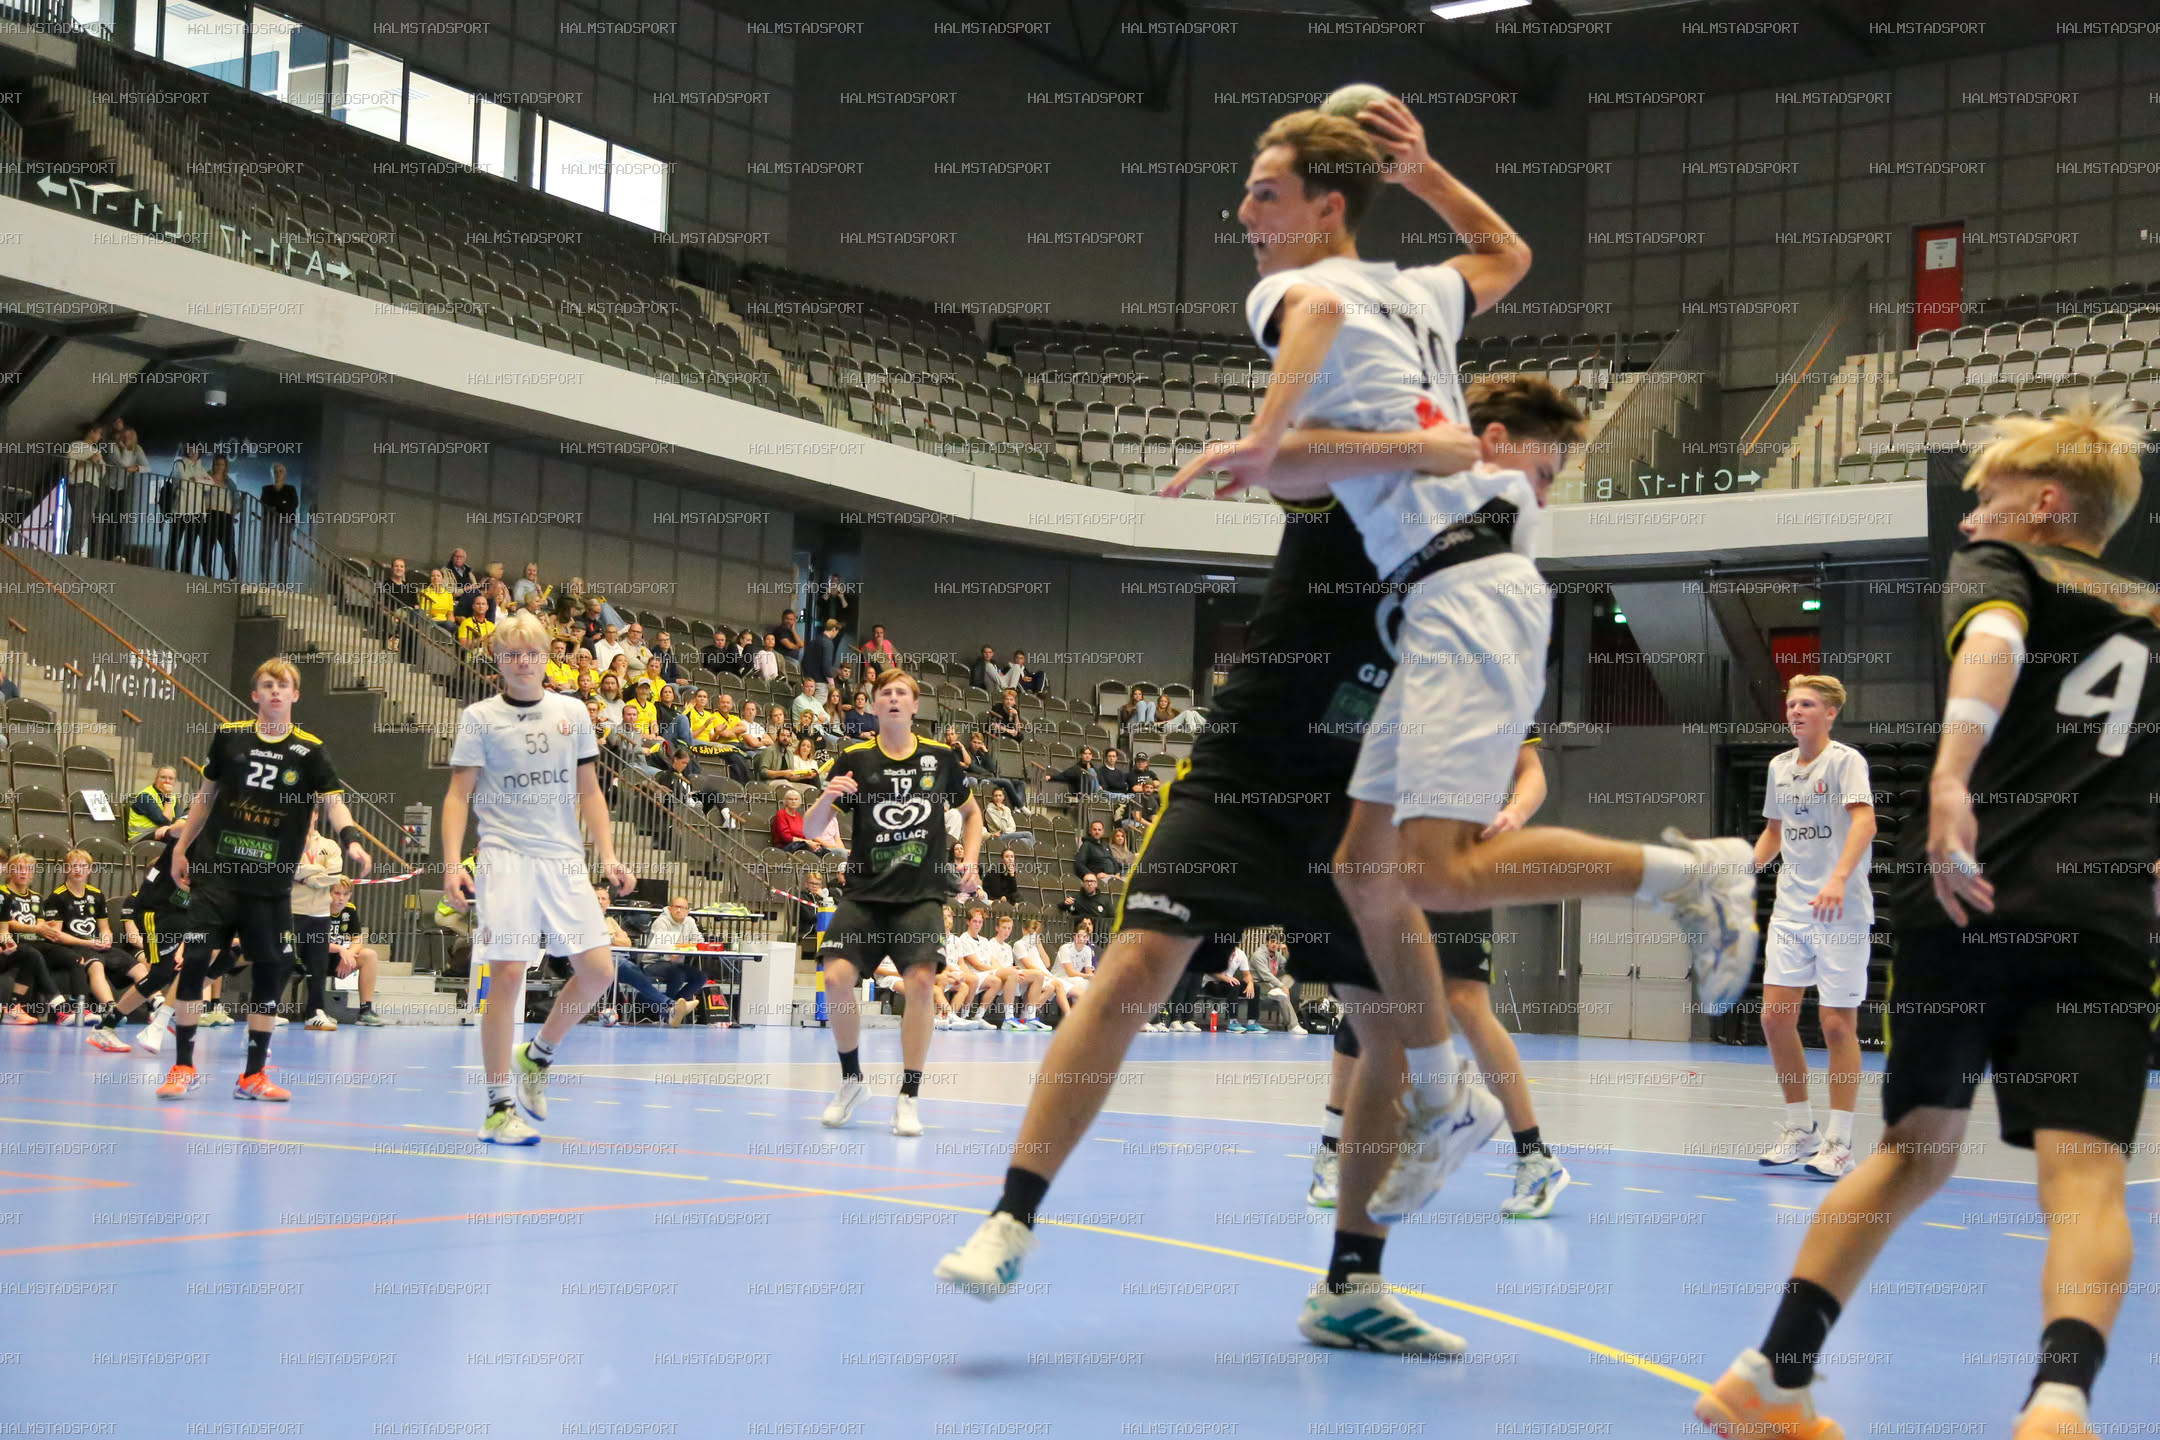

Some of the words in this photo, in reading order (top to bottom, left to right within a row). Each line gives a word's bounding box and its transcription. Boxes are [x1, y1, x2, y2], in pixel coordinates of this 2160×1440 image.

[2055, 633, 2150, 758] 4
[525, 732, 550, 755] 53
[250, 748, 284, 761] stadium
[246, 761, 279, 790] 22
[890, 777, 913, 798] 19
[876, 833, 890, 843] GB
[893, 829, 927, 841] GLACE
[233, 845, 266, 859] HUSET
